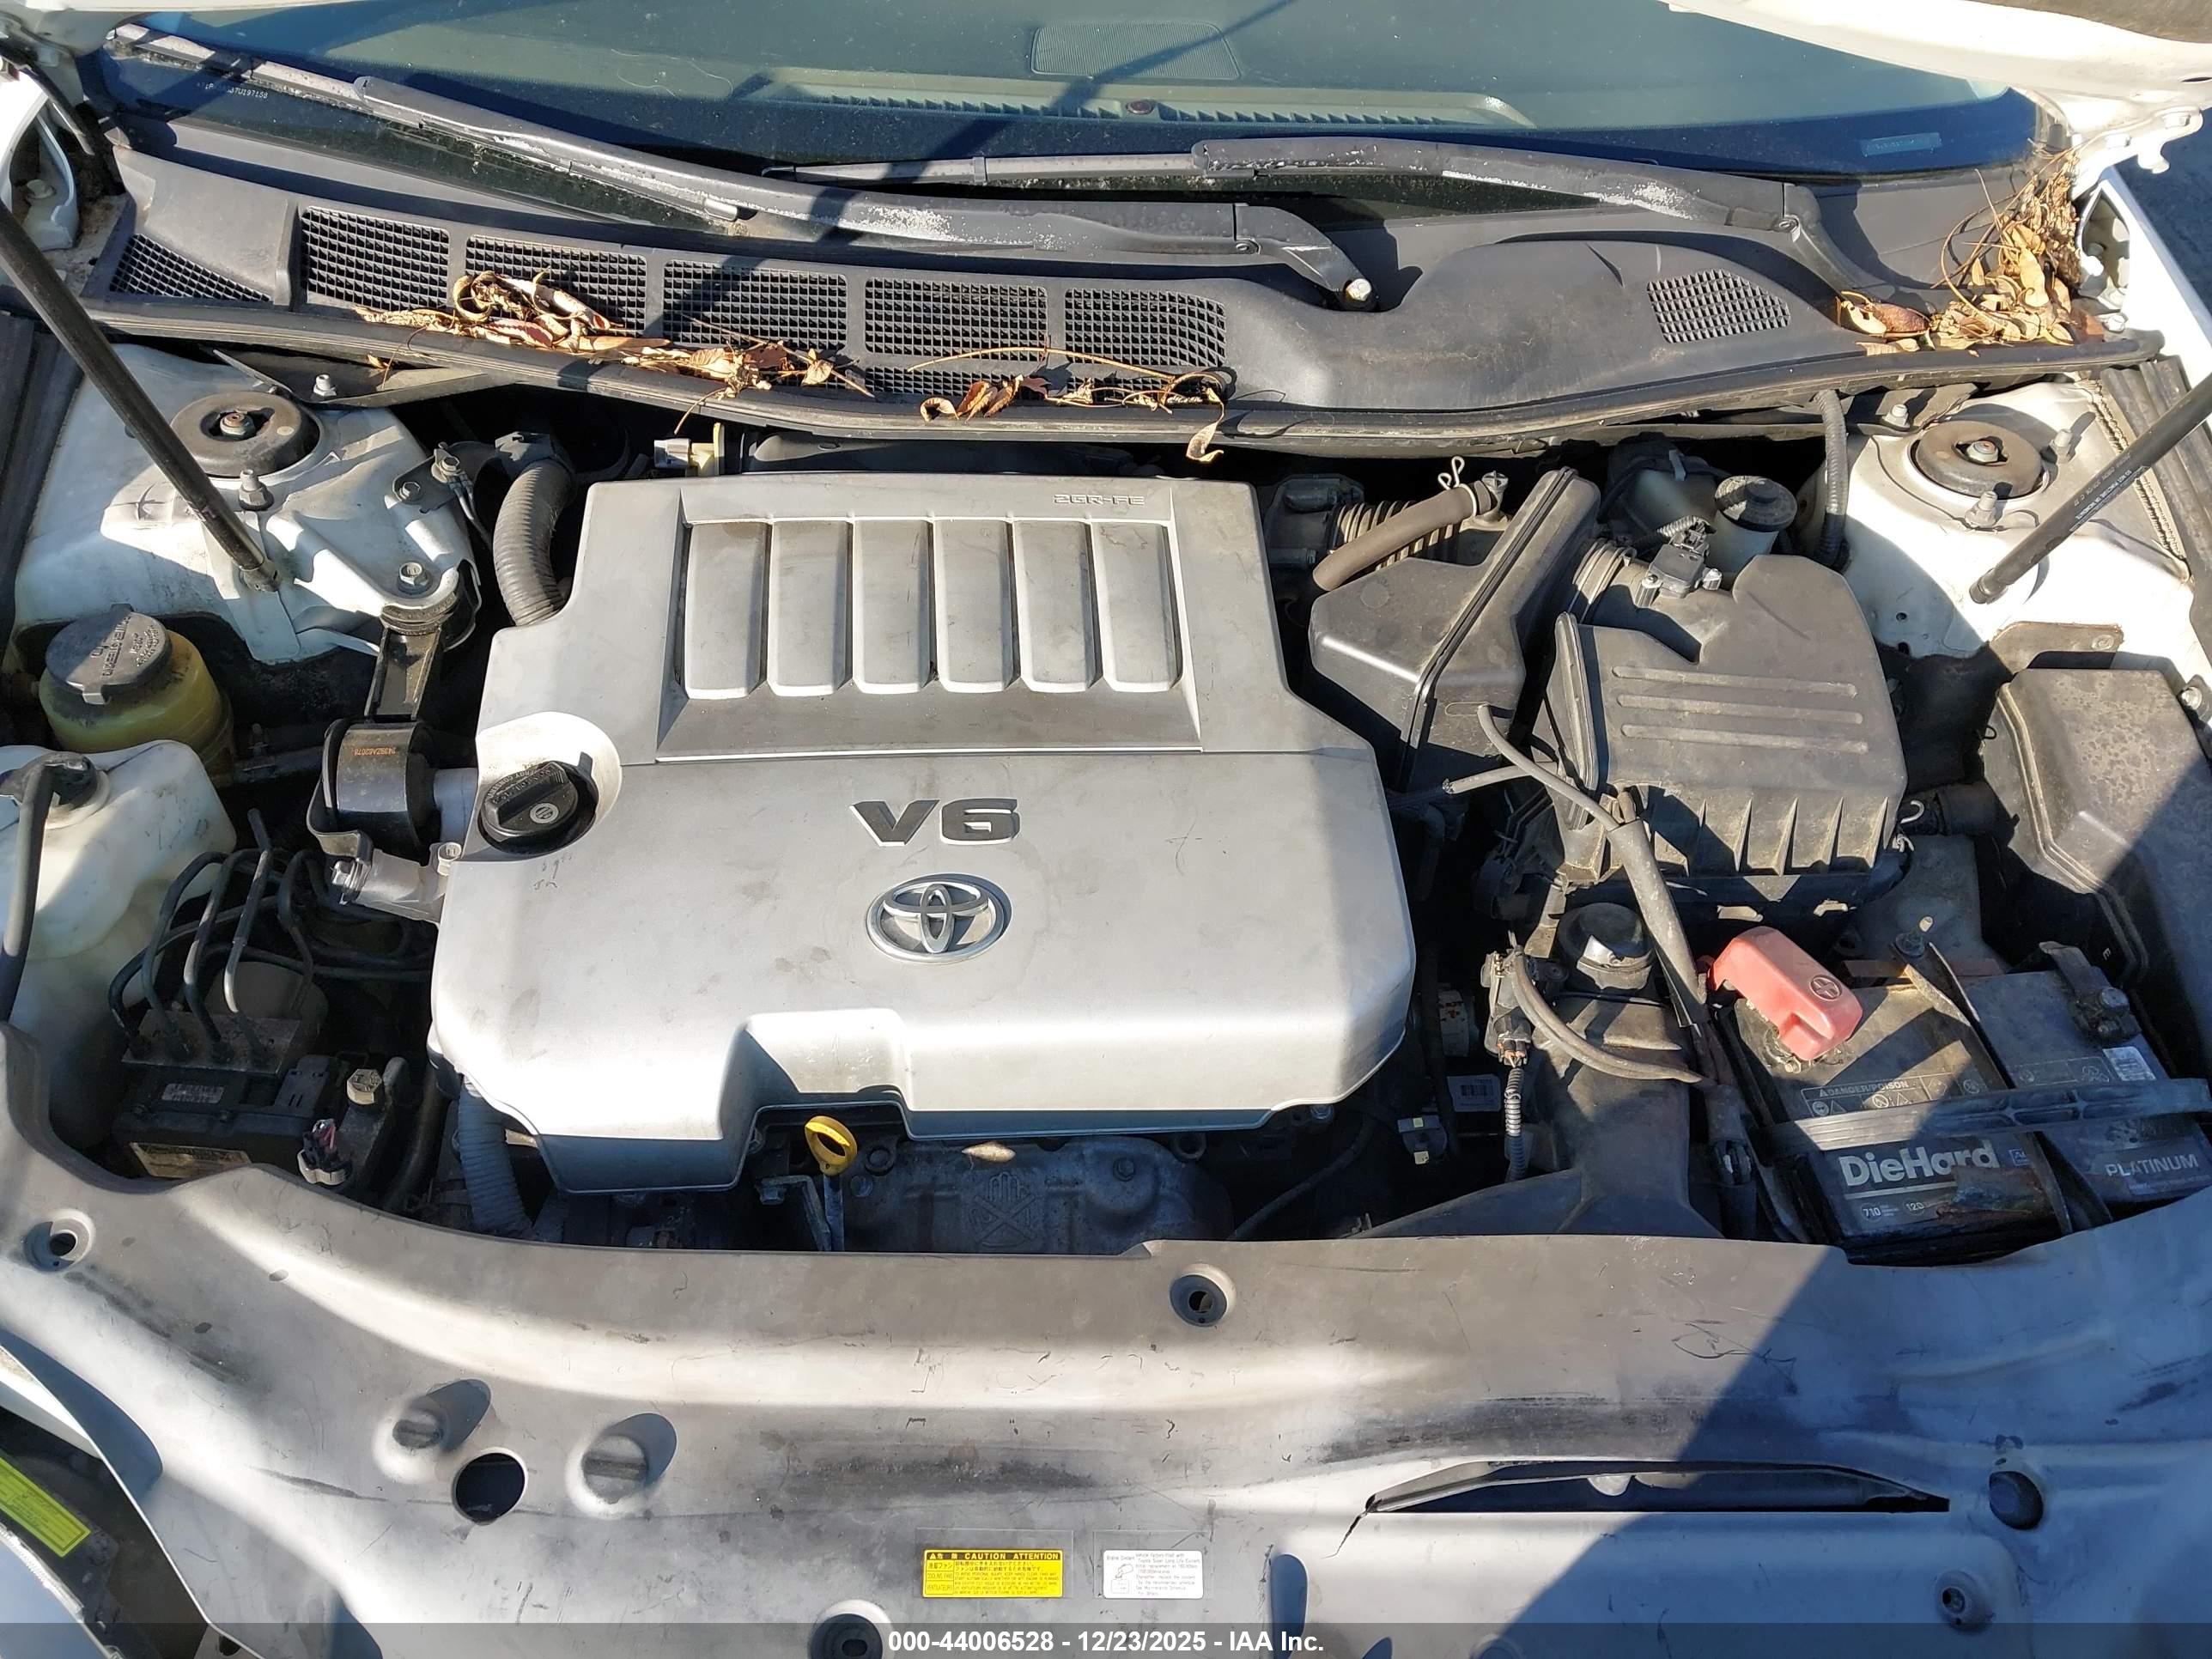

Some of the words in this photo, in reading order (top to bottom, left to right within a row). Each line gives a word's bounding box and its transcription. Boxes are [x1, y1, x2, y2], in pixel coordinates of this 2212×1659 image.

[1054, 494, 1146, 506] 2GR-FE
[848, 797, 1021, 847] V6
[1838, 1139, 2001, 1187] DieHard
[2105, 1153, 2199, 1177] PLATINUM
[1862, 1206, 1882, 1218] 710
